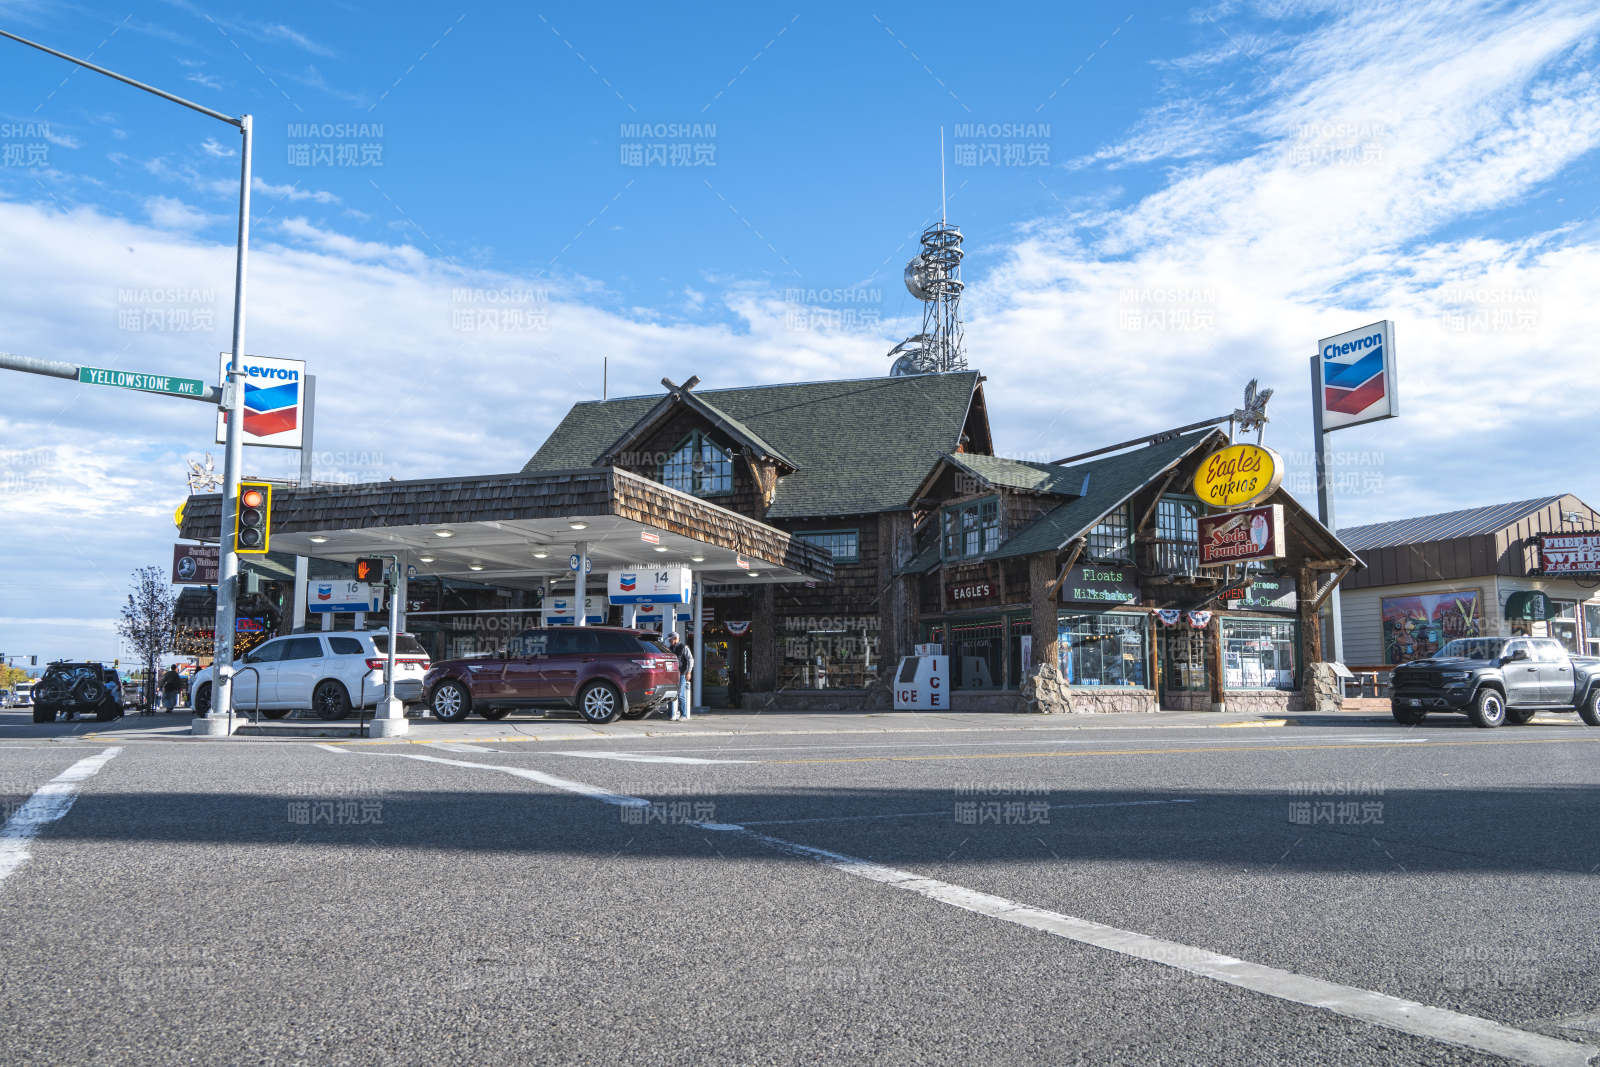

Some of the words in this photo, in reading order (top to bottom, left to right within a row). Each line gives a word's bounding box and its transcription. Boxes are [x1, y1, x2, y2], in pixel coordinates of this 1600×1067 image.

[1324, 333, 1382, 360] Chevron
[89, 368, 170, 392] YELLOWSTONE
[1206, 448, 1261, 484] Eagle's
[1210, 477, 1258, 498] CURIOS
[1212, 528, 1247, 546] Soda
[1204, 540, 1260, 560] Fountain
[655, 572, 668, 584] 14
[1082, 569, 1122, 582] Floats
[347, 582, 358, 593] 16
[954, 585, 990, 600] EAGLE'S
[930, 659, 940, 706] ICE
[897, 690, 918, 702] ICE
